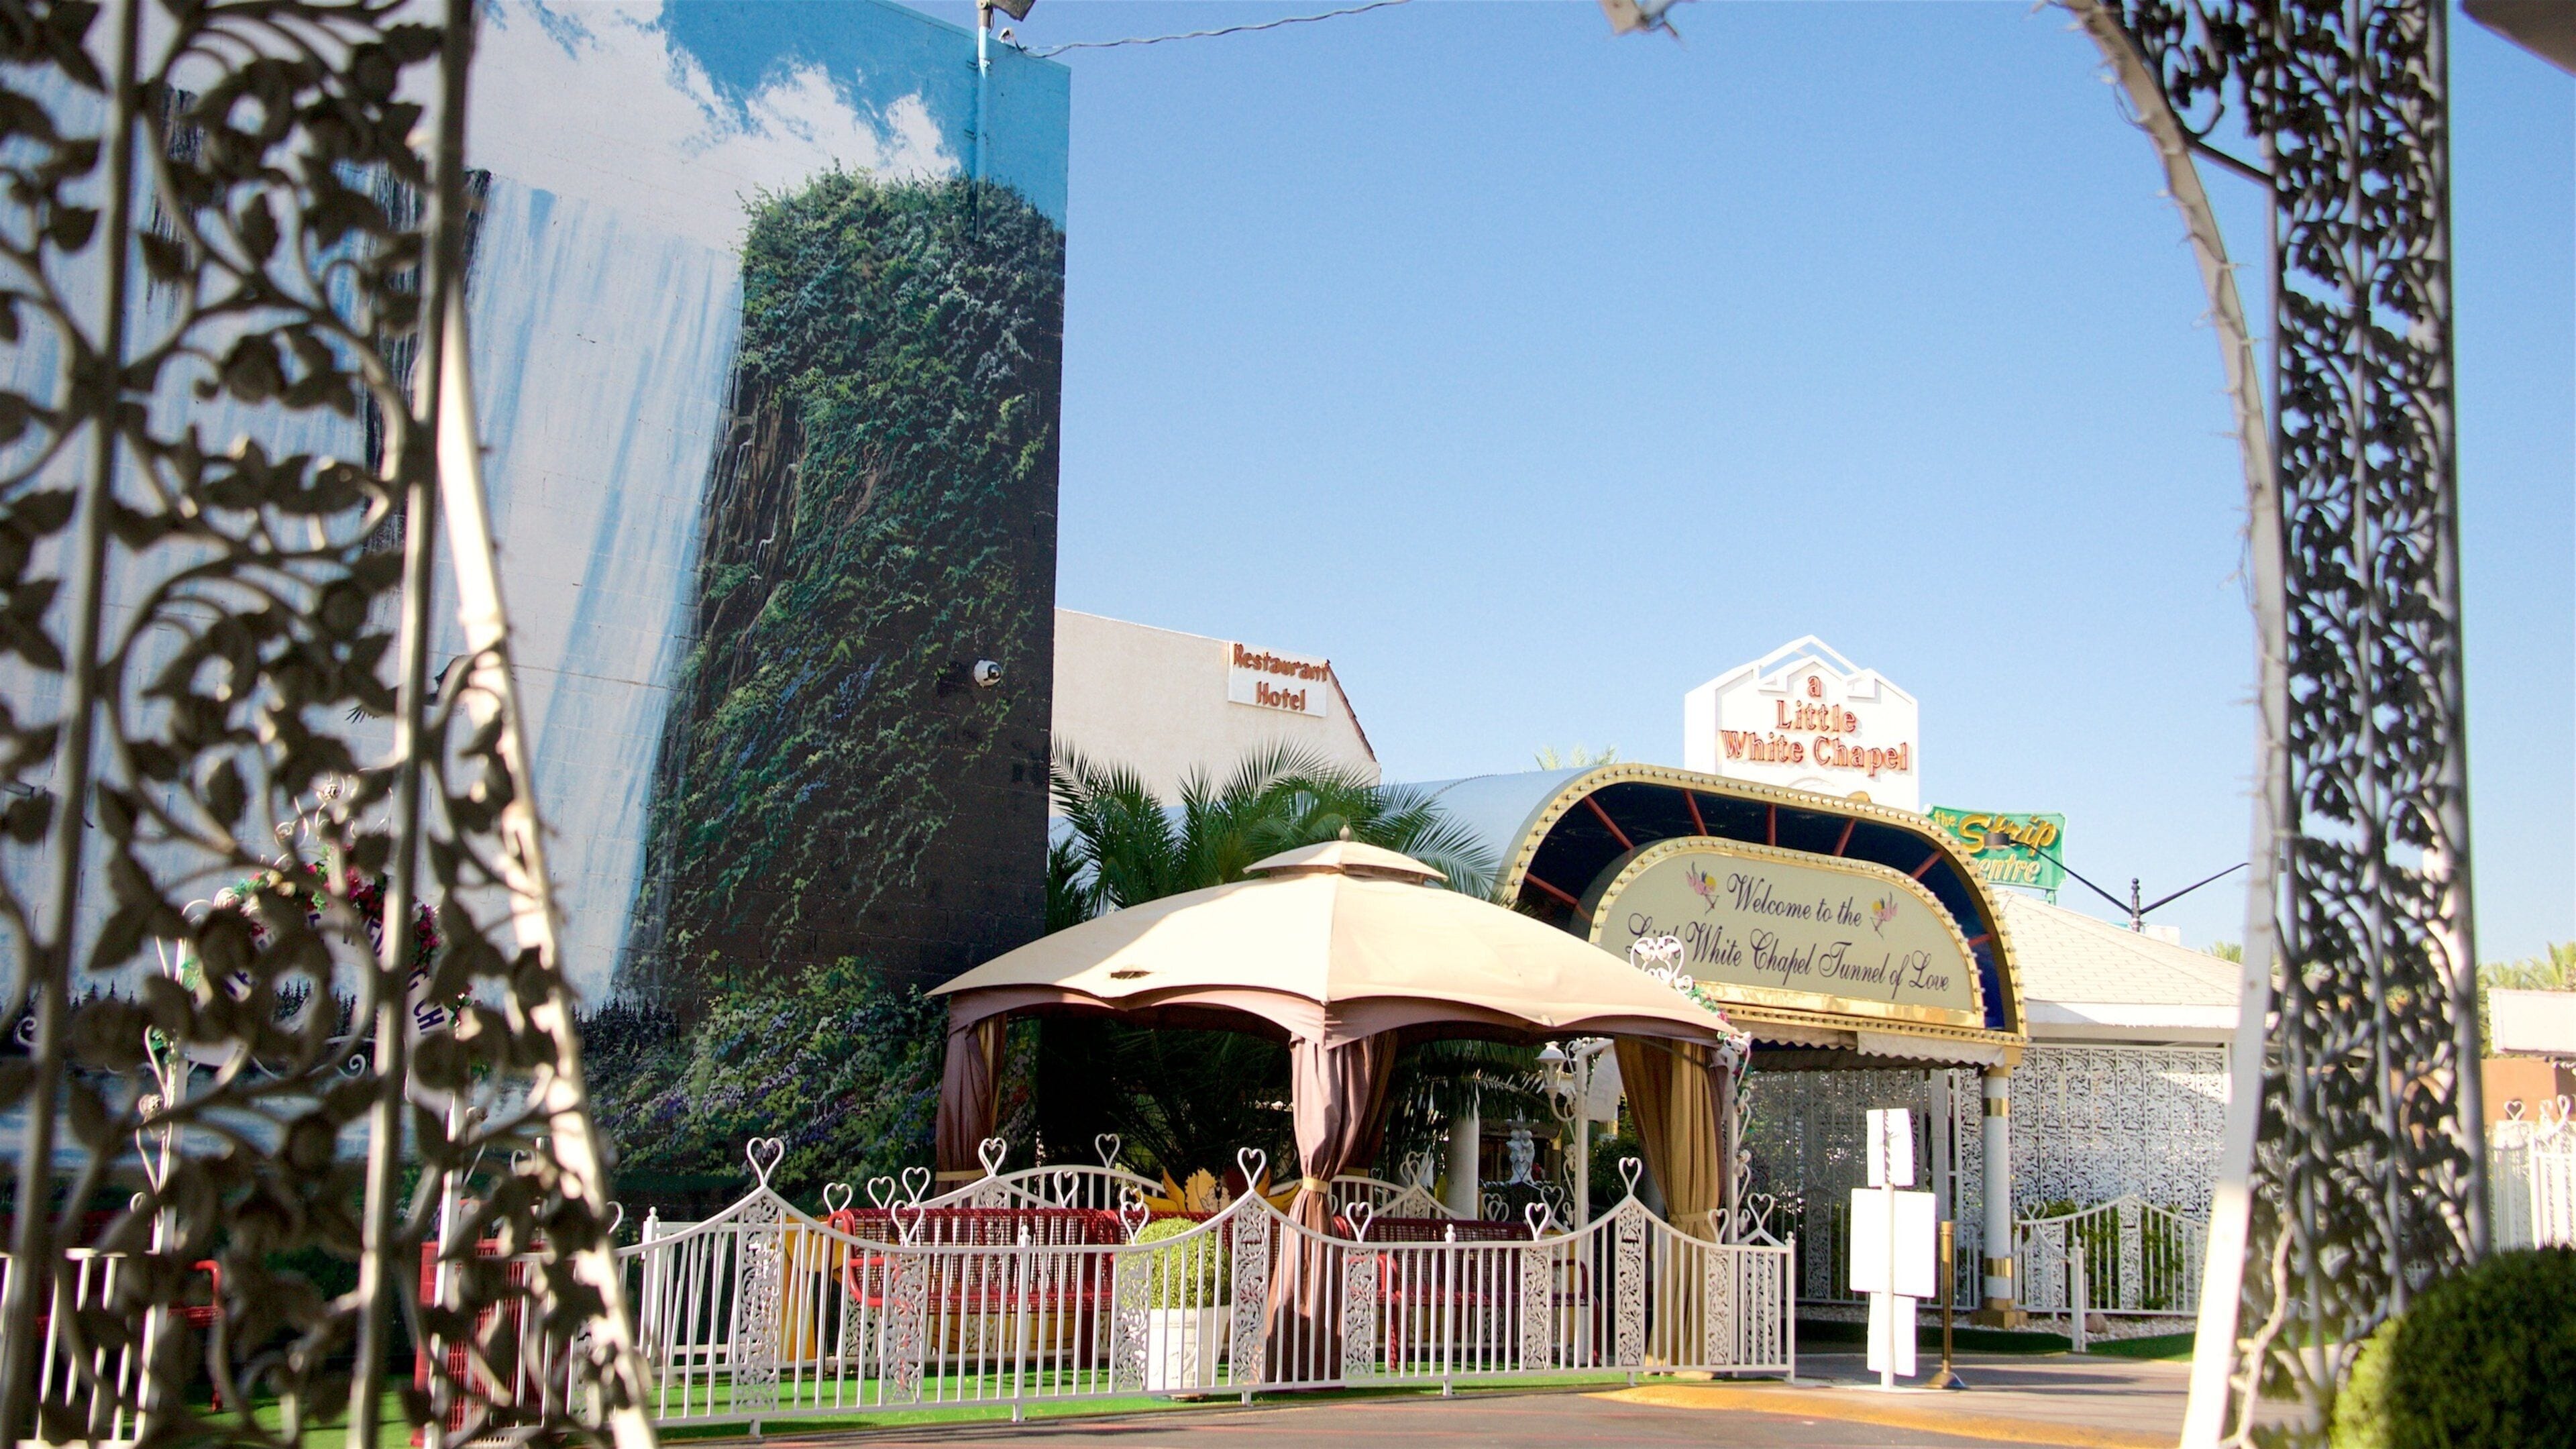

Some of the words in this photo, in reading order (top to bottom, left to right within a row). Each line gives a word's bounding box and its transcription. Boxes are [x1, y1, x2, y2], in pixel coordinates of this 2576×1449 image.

[1233, 643, 1329, 682] Restaurant
[1256, 681, 1306, 711] Hotel
[1807, 674, 1822, 697] a
[1775, 700, 1858, 733] Little
[1719, 729, 1805, 763] White
[1813, 735, 1910, 777] Chapel
[1976, 853, 2042, 883] entre
[1727, 873, 1812, 920] Welcome
[1816, 896, 1833, 922] to
[1837, 896, 1862, 928] the
[1684, 920, 1742, 967] White
[1750, 928, 1816, 985] Chapel
[1819, 941, 1890, 985] Tunnel
[1890, 953, 1909, 1000] of
[1909, 949, 1950, 992] Love
